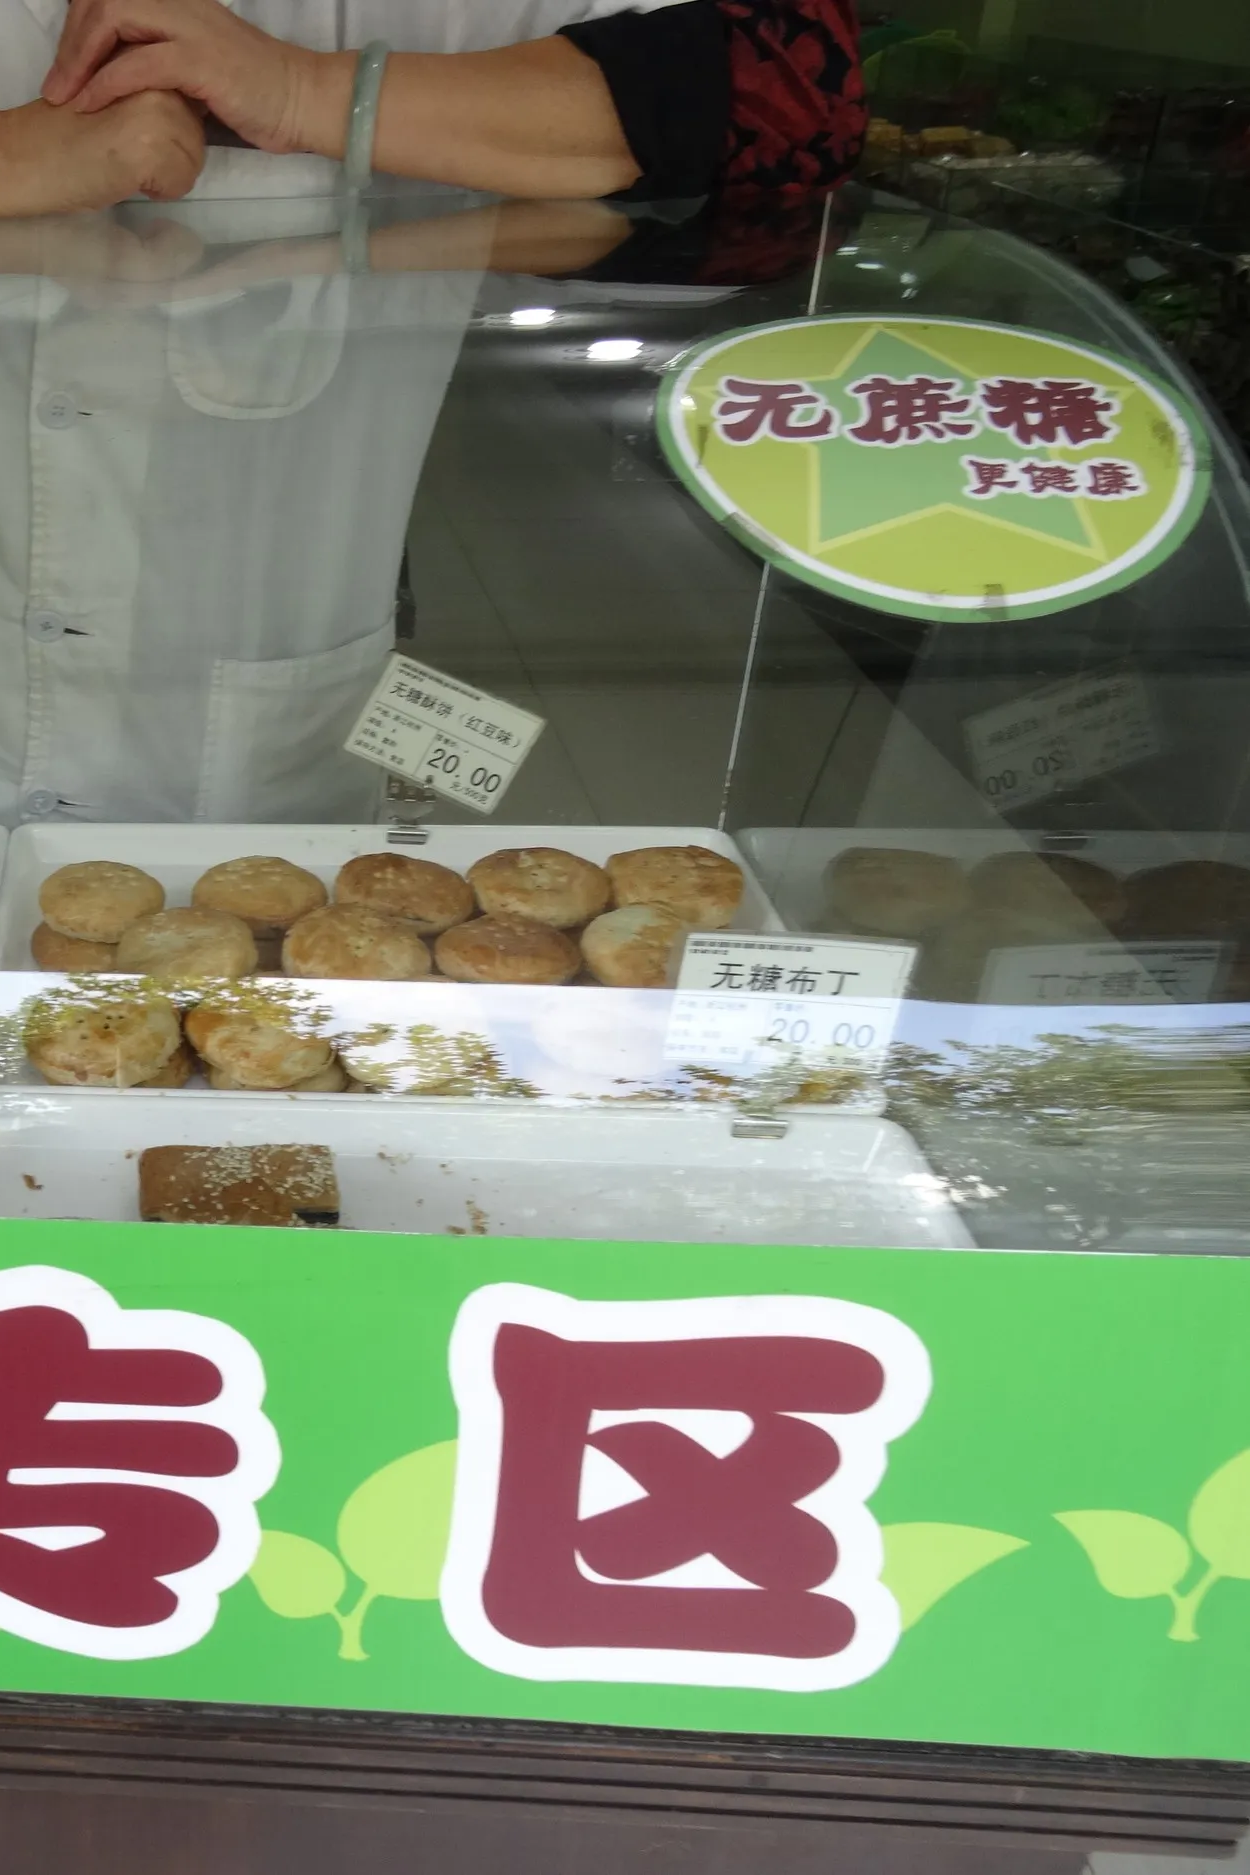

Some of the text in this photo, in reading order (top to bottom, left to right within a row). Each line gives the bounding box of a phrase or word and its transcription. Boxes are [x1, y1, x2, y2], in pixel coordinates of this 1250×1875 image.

[716, 377, 1113, 445] 无蔗糖
[966, 459, 1141, 496] 更健康
[426, 747, 502, 793] 20.00
[710, 962, 861, 996] 无糖布丁
[767, 1017, 876, 1049] 20.00
